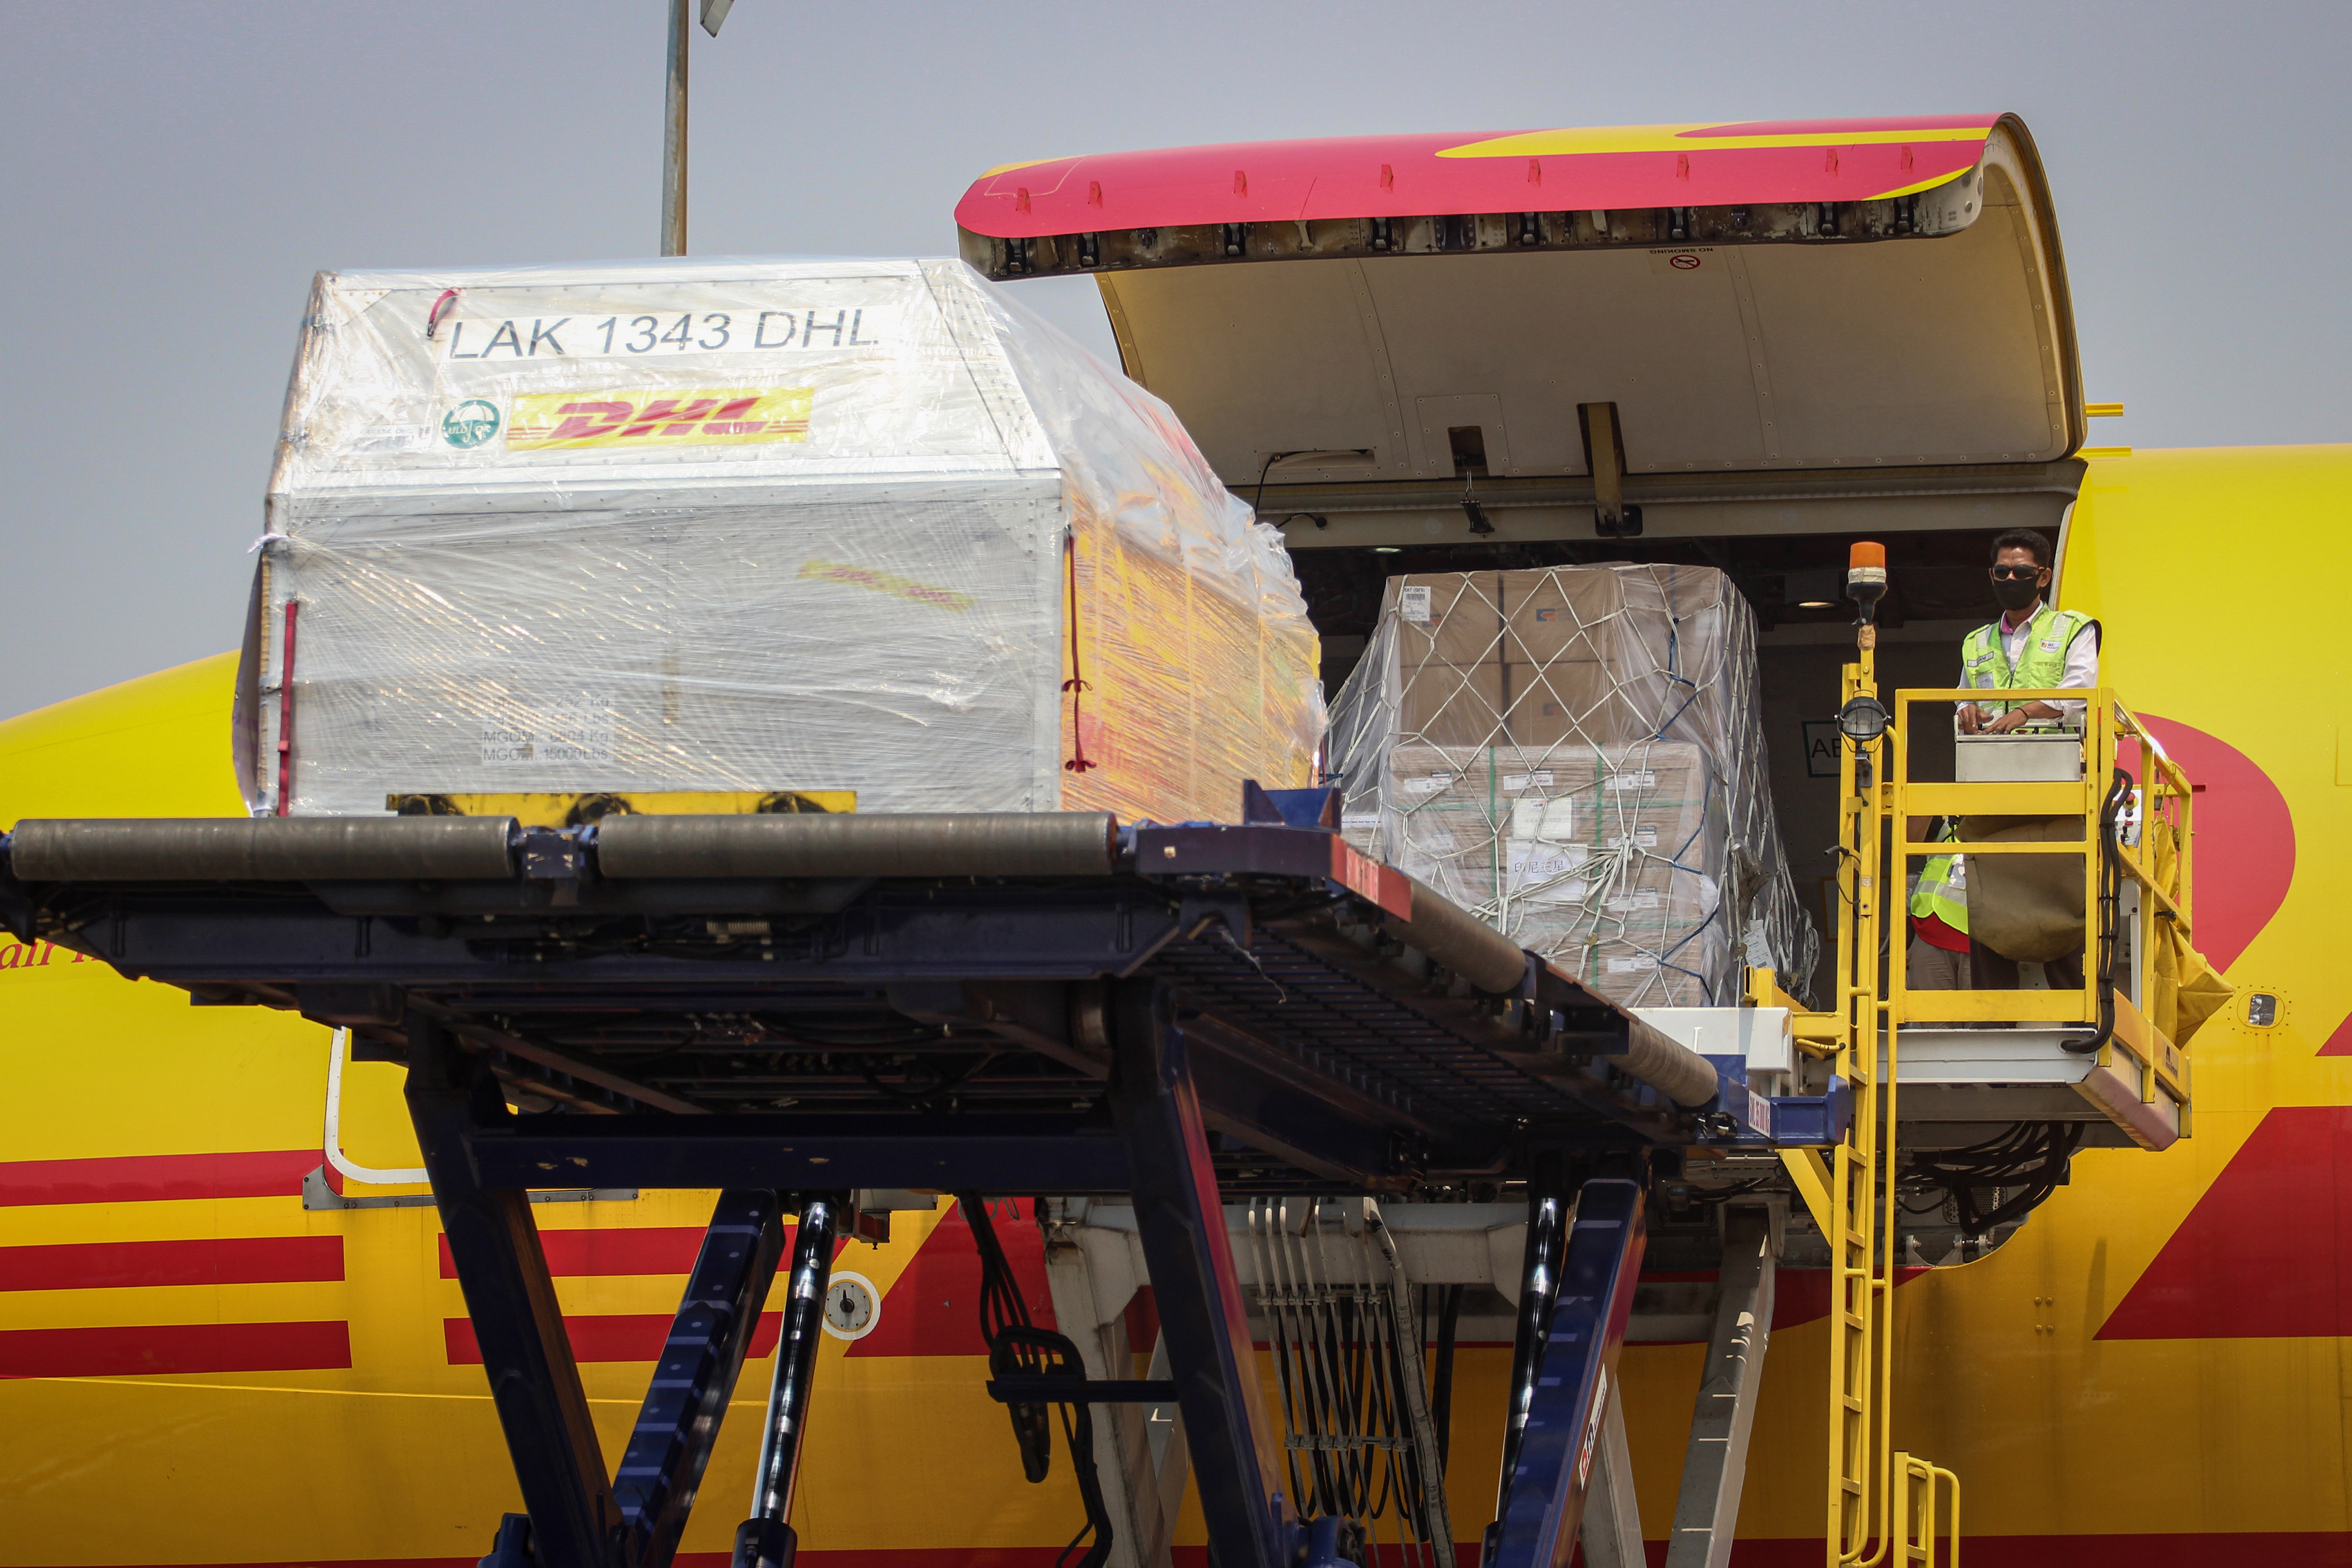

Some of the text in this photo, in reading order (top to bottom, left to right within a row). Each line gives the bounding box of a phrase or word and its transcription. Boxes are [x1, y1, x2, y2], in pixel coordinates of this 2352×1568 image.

[450, 309, 879, 359] LAK 1343 DHL
[547, 397, 769, 439] DHL
[1515, 861, 1564, 873] 印尼三星
